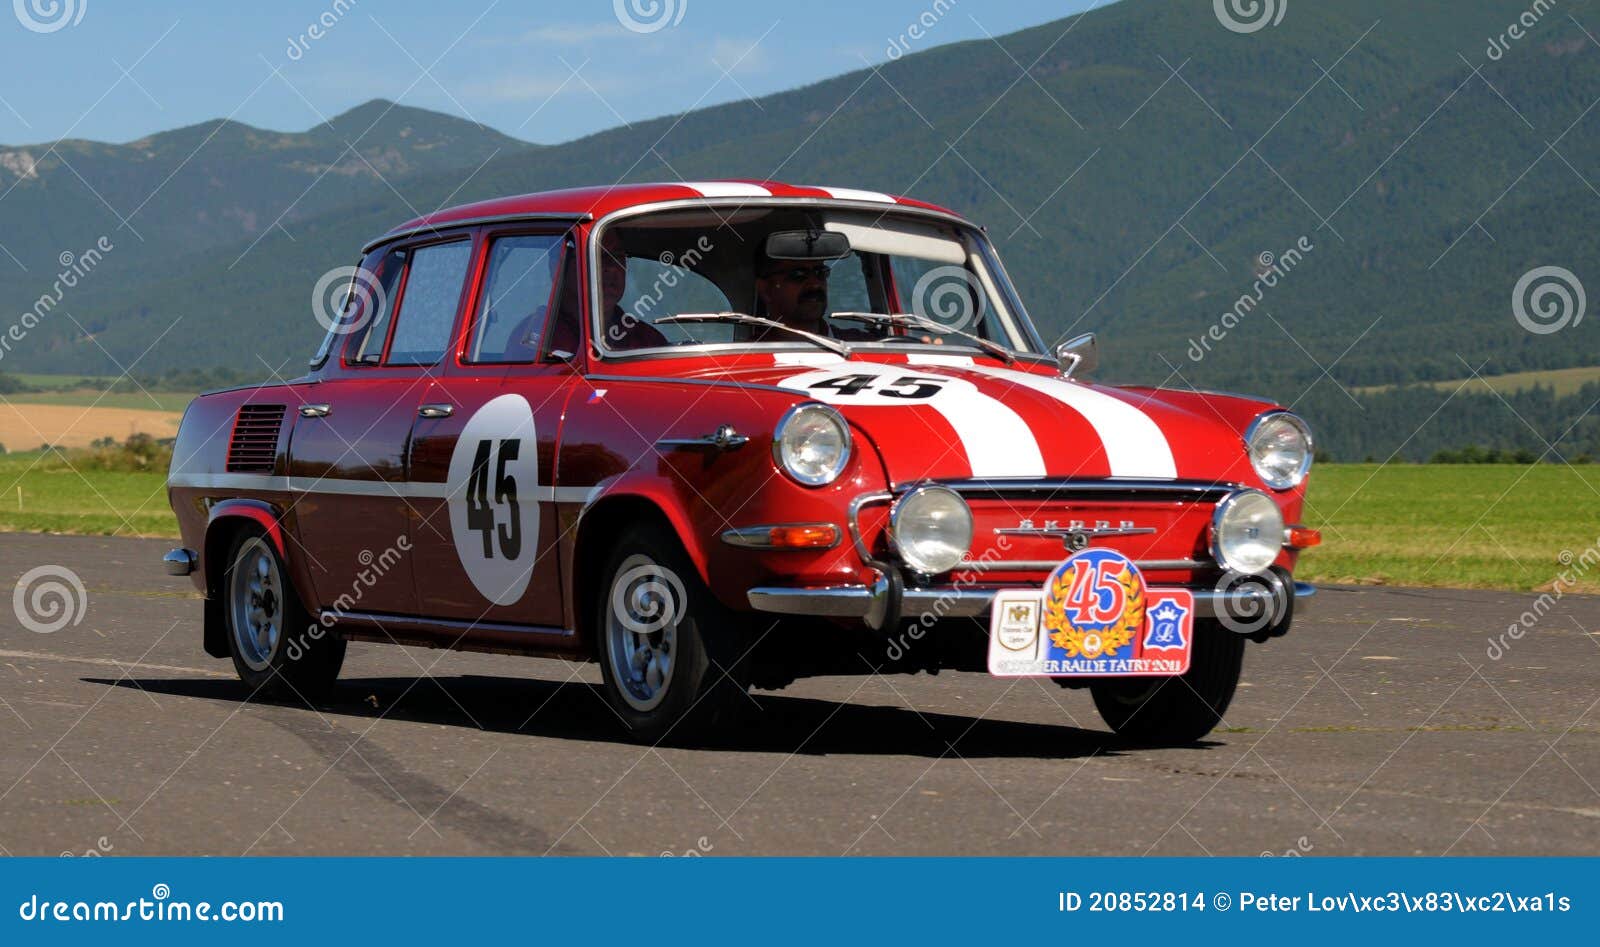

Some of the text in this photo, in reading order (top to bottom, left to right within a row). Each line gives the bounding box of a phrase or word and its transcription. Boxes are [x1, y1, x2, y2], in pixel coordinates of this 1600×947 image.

[808, 374, 948, 398] 45
[466, 439, 522, 561] 45
[1064, 559, 1127, 624] 45
[1061, 659, 1107, 672] RALLYE
[1108, 659, 1151, 671] TATRY
